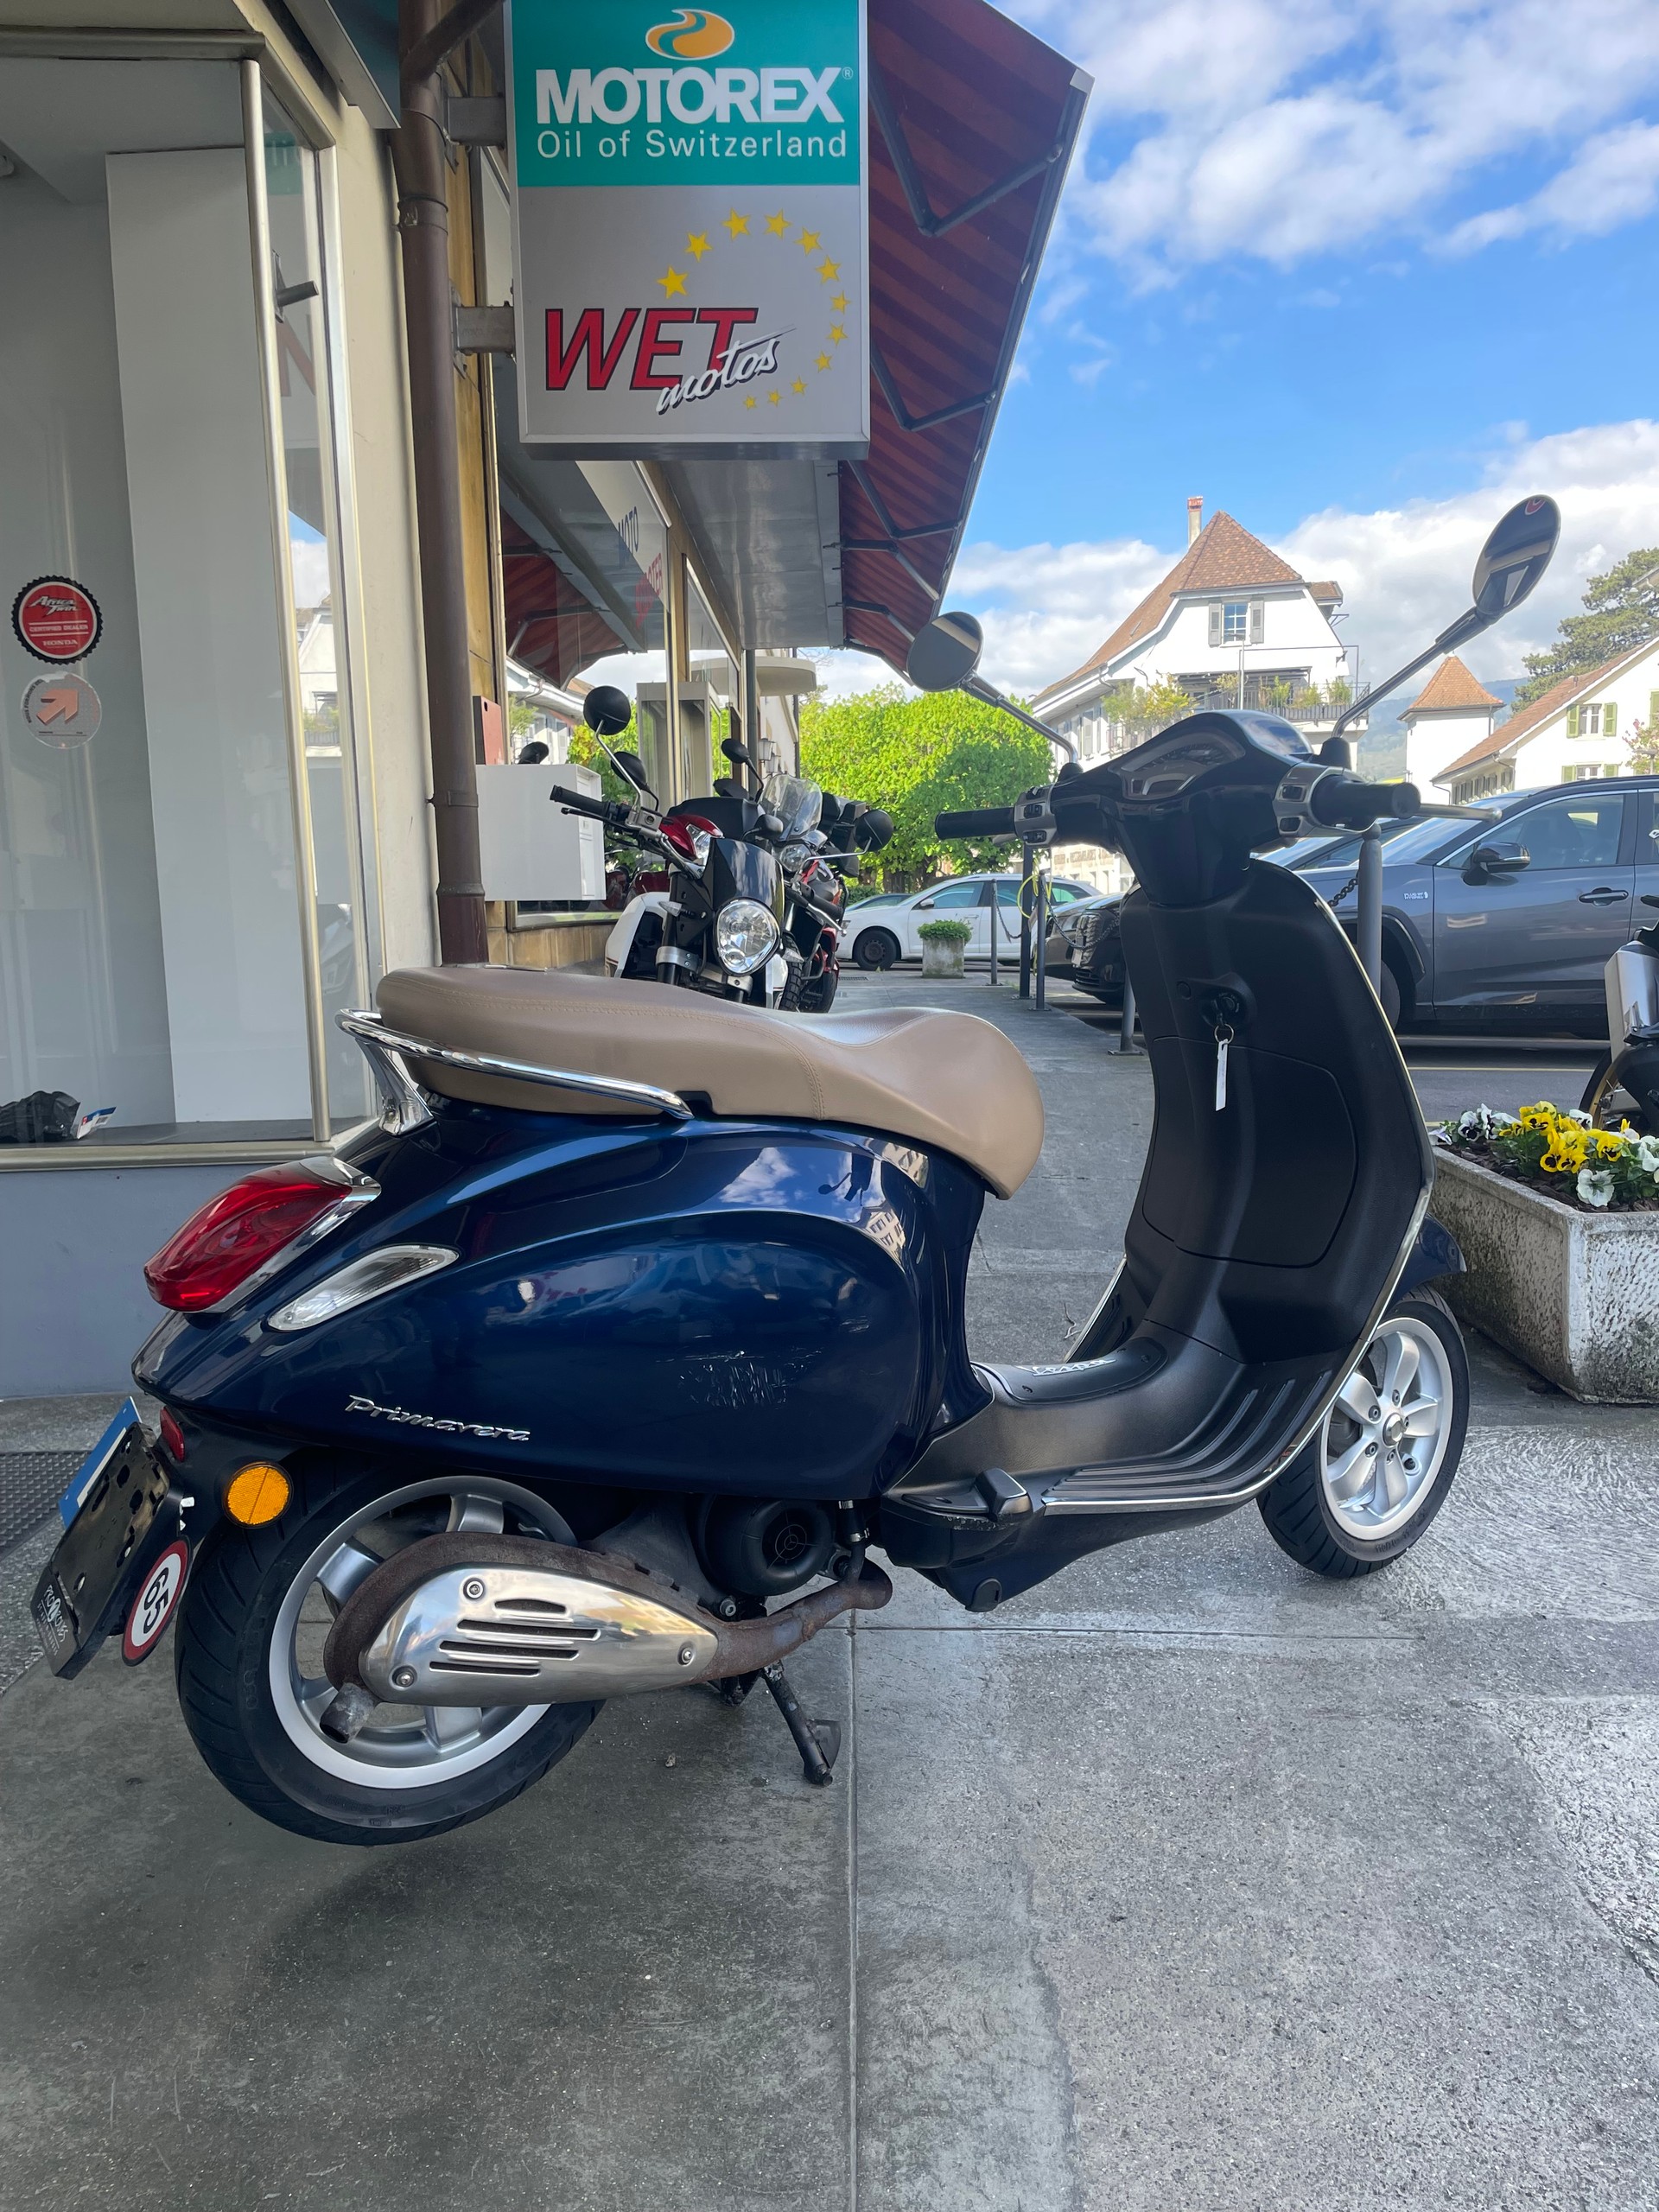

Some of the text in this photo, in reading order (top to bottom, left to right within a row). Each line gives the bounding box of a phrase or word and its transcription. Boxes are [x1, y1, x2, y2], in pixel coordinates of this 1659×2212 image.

[537, 129, 847, 159] Oil of Switzerland
[544, 308, 759, 391] WET
[655, 324, 797, 416] motos
[345, 1395, 531, 1441] Primavera
[143, 1567, 169, 1634] 65
